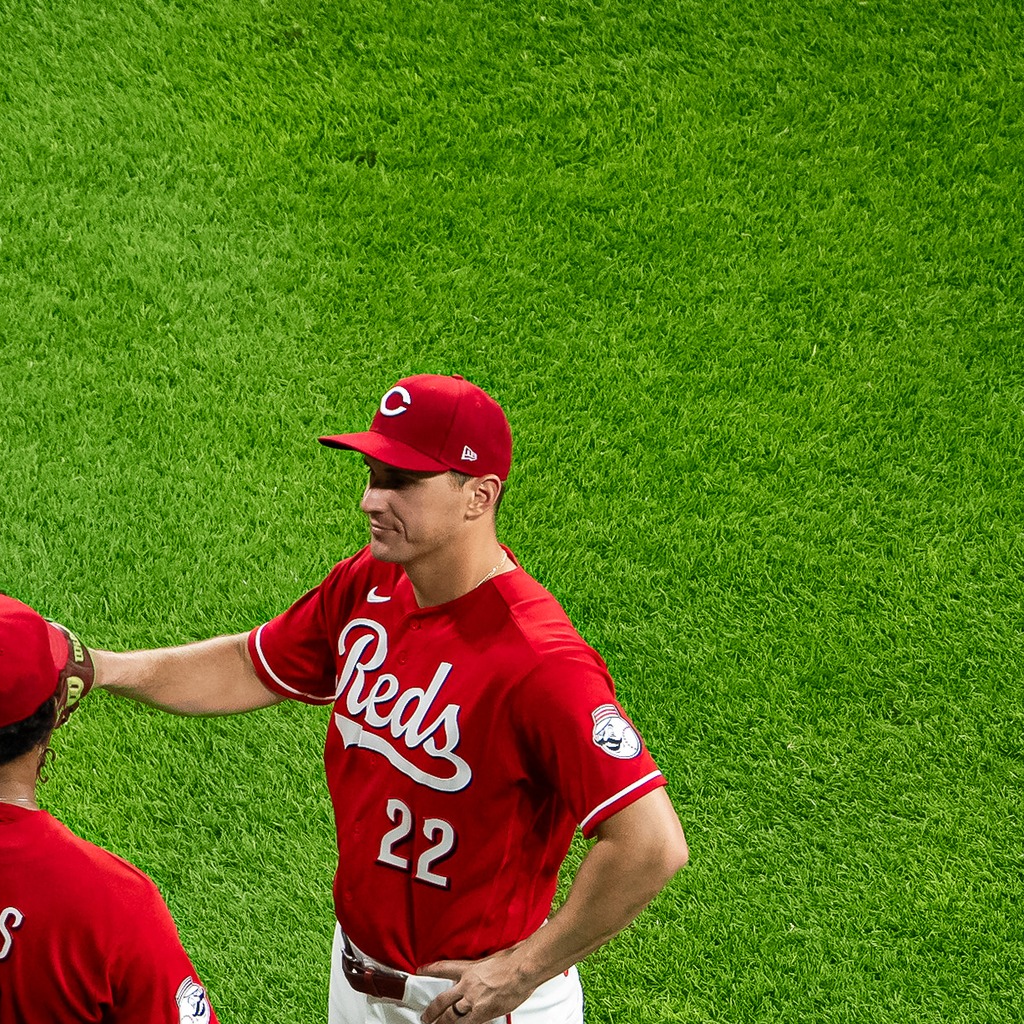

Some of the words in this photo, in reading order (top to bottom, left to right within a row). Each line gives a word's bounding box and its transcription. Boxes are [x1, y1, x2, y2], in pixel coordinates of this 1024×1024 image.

[380, 385, 412, 417] C
[335, 617, 472, 793] Reds
[377, 798, 455, 887] 22
